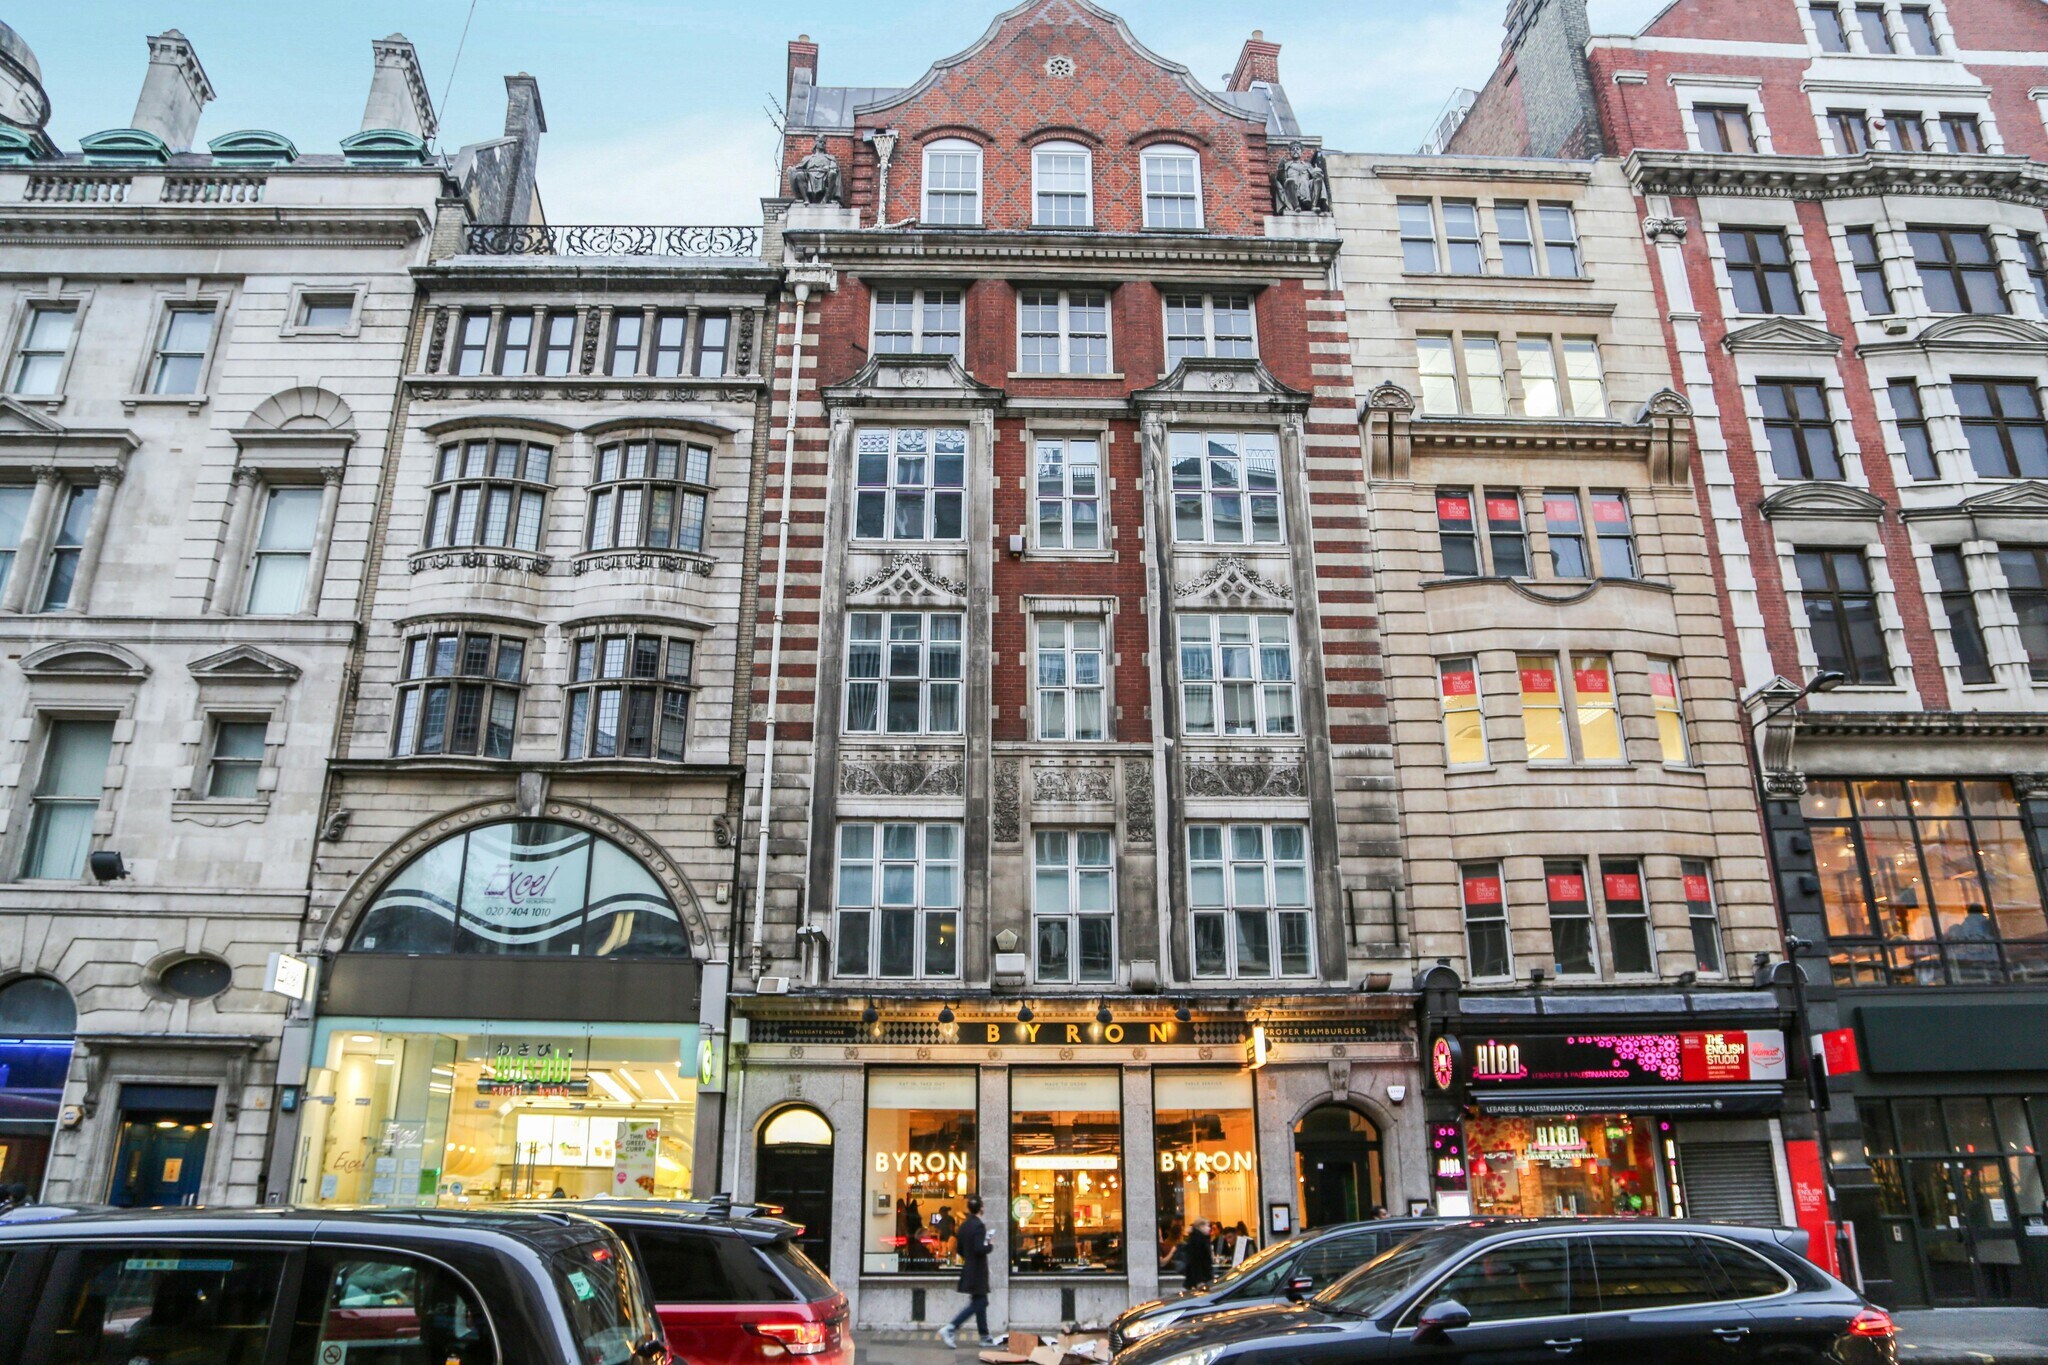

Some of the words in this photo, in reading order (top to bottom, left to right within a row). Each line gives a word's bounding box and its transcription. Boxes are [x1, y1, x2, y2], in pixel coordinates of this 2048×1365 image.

[484, 864, 559, 904] Excel
[486, 907, 504, 916] 020
[506, 907, 529, 916] 7404
[532, 907, 552, 917] 1010
[987, 1024, 1168, 1043] BYRON
[1264, 1028, 1300, 1036] PROPER
[1303, 1027, 1368, 1036] HAMBURGERS
[1705, 1034, 1725, 1045] THE
[497, 1042, 552, 1057] わさび
[1705, 1043, 1745, 1055] ENGLISH
[495, 1048, 574, 1083] wasabi
[1707, 1054, 1740, 1065] STUDIO
[1570, 1070, 1608, 1078] PALESTINIAN
[1609, 1070, 1630, 1078] FOOD
[492, 1085, 522, 1096] sushi
[1486, 1105, 1517, 1113] LEBANESE
[1525, 1104, 1564, 1112] PALESTINIAN
[1537, 1126, 1580, 1147] HIBA
[333, 1151, 372, 1174] Excel
[876, 1152, 968, 1173] BYRON
[1161, 1151, 1252, 1172] BYRON
